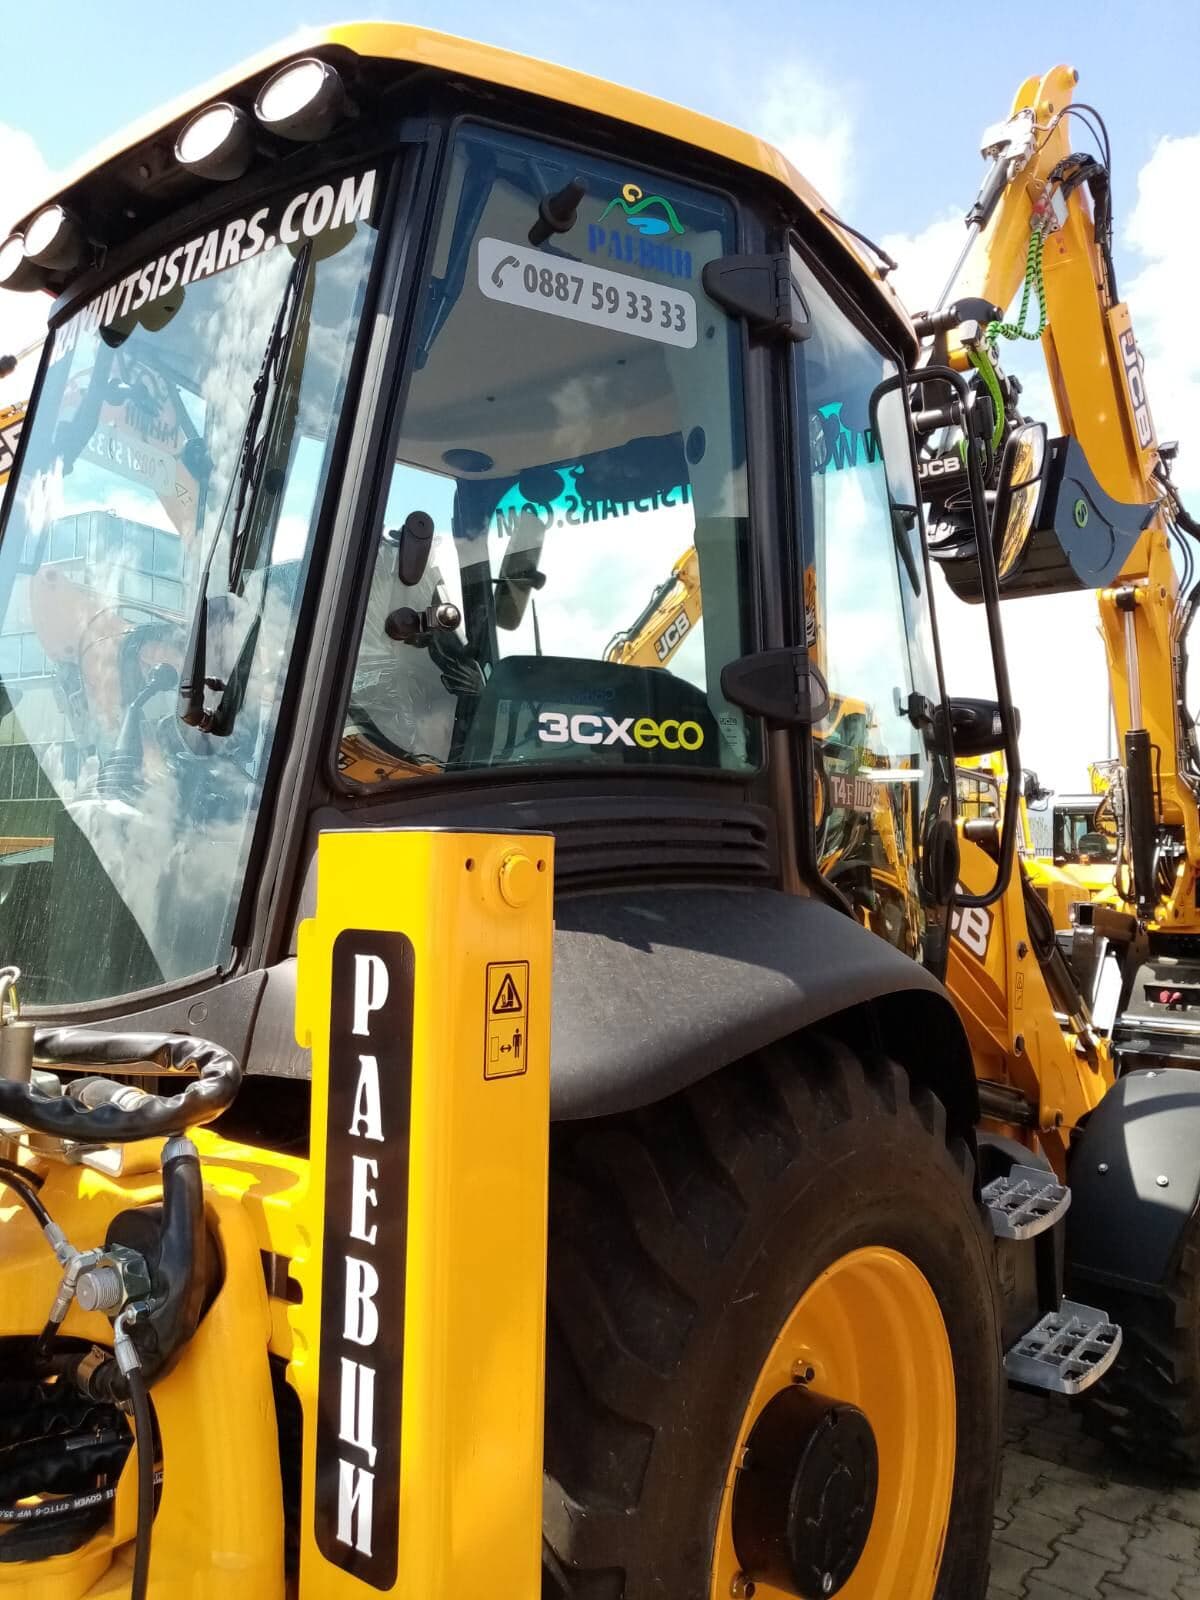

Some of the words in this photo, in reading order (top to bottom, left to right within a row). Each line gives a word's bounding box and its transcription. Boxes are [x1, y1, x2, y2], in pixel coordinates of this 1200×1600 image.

[523, 264, 584, 304] 0887
[591, 282, 620, 313] 59
[626, 291, 653, 323] 33
[660, 301, 686, 332] 33
[1119, 330, 1152, 447] JCB
[654, 611, 690, 660] JCB
[336, 953, 391, 1558] РАЕВЦИ
